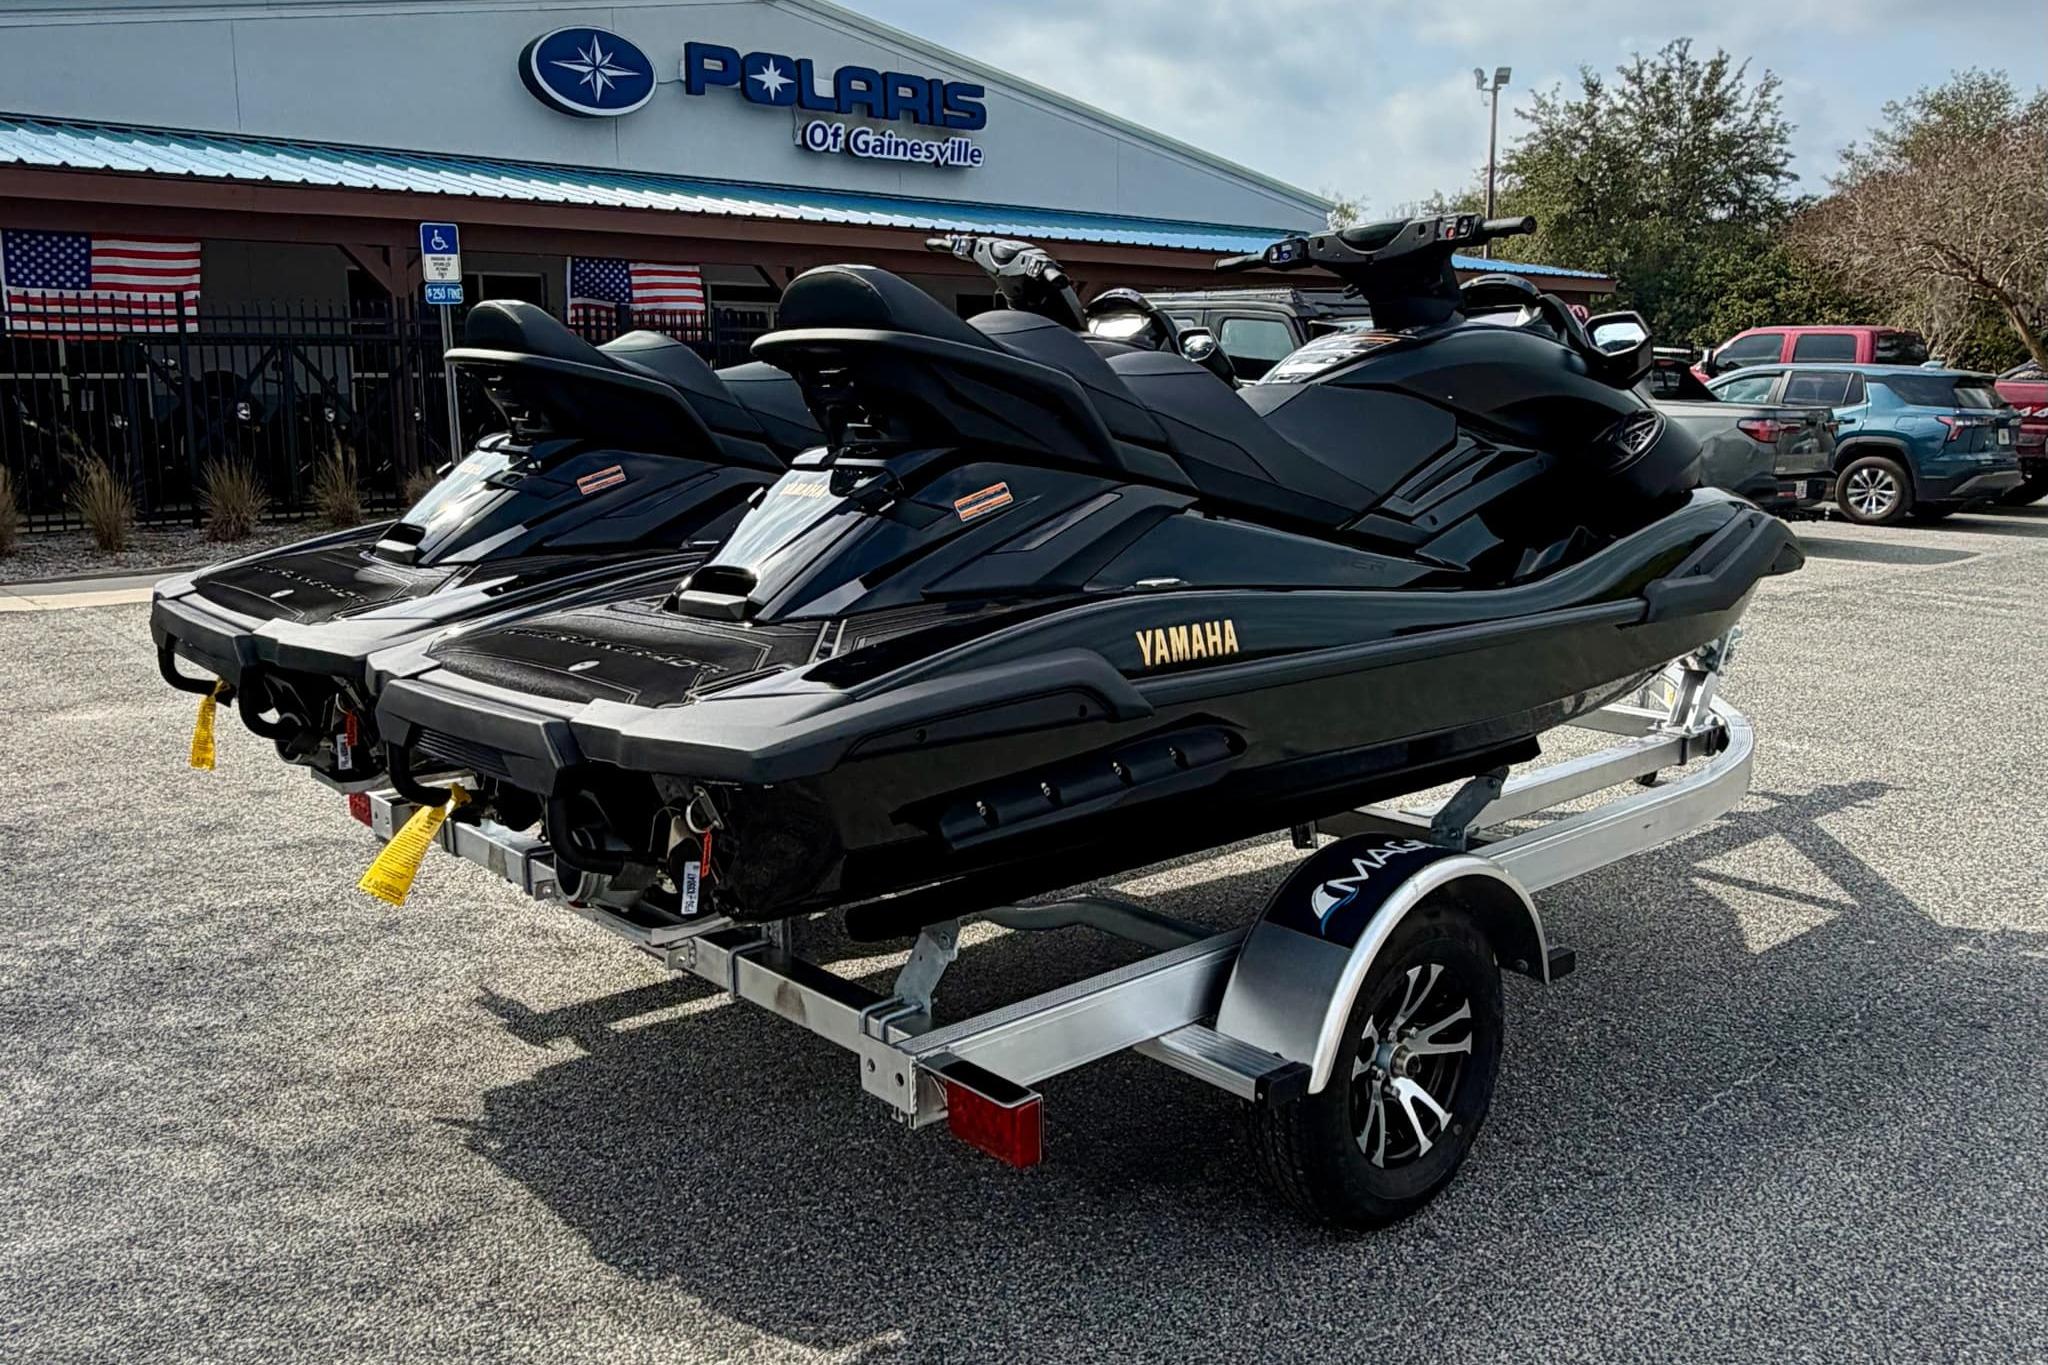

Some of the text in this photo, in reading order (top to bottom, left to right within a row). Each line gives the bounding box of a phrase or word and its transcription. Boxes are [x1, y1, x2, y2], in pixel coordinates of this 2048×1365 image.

[684, 41, 986, 130] POLARIS
[806, 120, 985, 166] Of Gainesville
[427, 287, 446, 300] $250
[1135, 619, 1240, 667] YAMAHA
[1326, 839, 1434, 893] MAG
